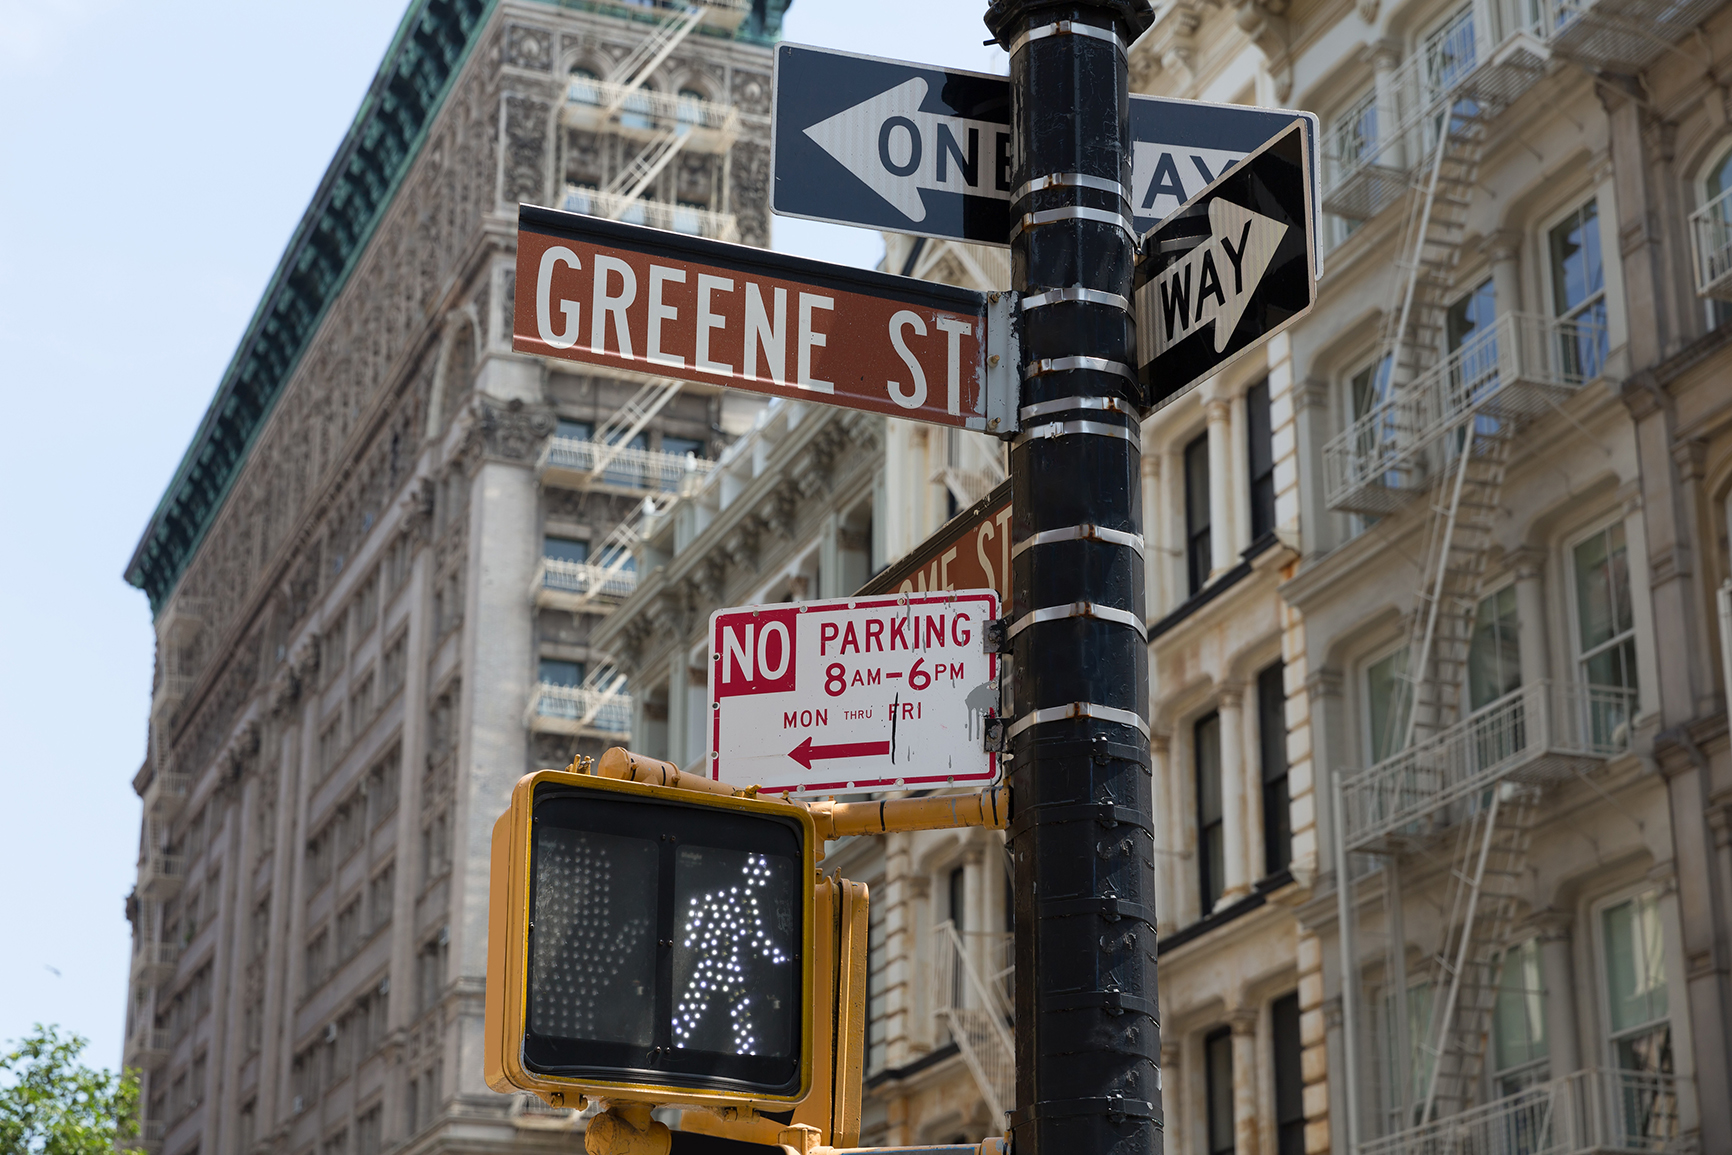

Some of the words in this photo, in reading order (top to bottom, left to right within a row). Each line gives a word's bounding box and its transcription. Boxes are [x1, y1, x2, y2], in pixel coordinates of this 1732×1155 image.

[1160, 219, 1253, 343] WAY
[536, 245, 835, 395] GREENE
[887, 309, 973, 417] ST
[721, 620, 791, 684] NO
[820, 612, 972, 656] PARKING
[783, 708, 829, 729] MON
[844, 709, 873, 721] THRU
[888, 702, 923, 721] FRI
